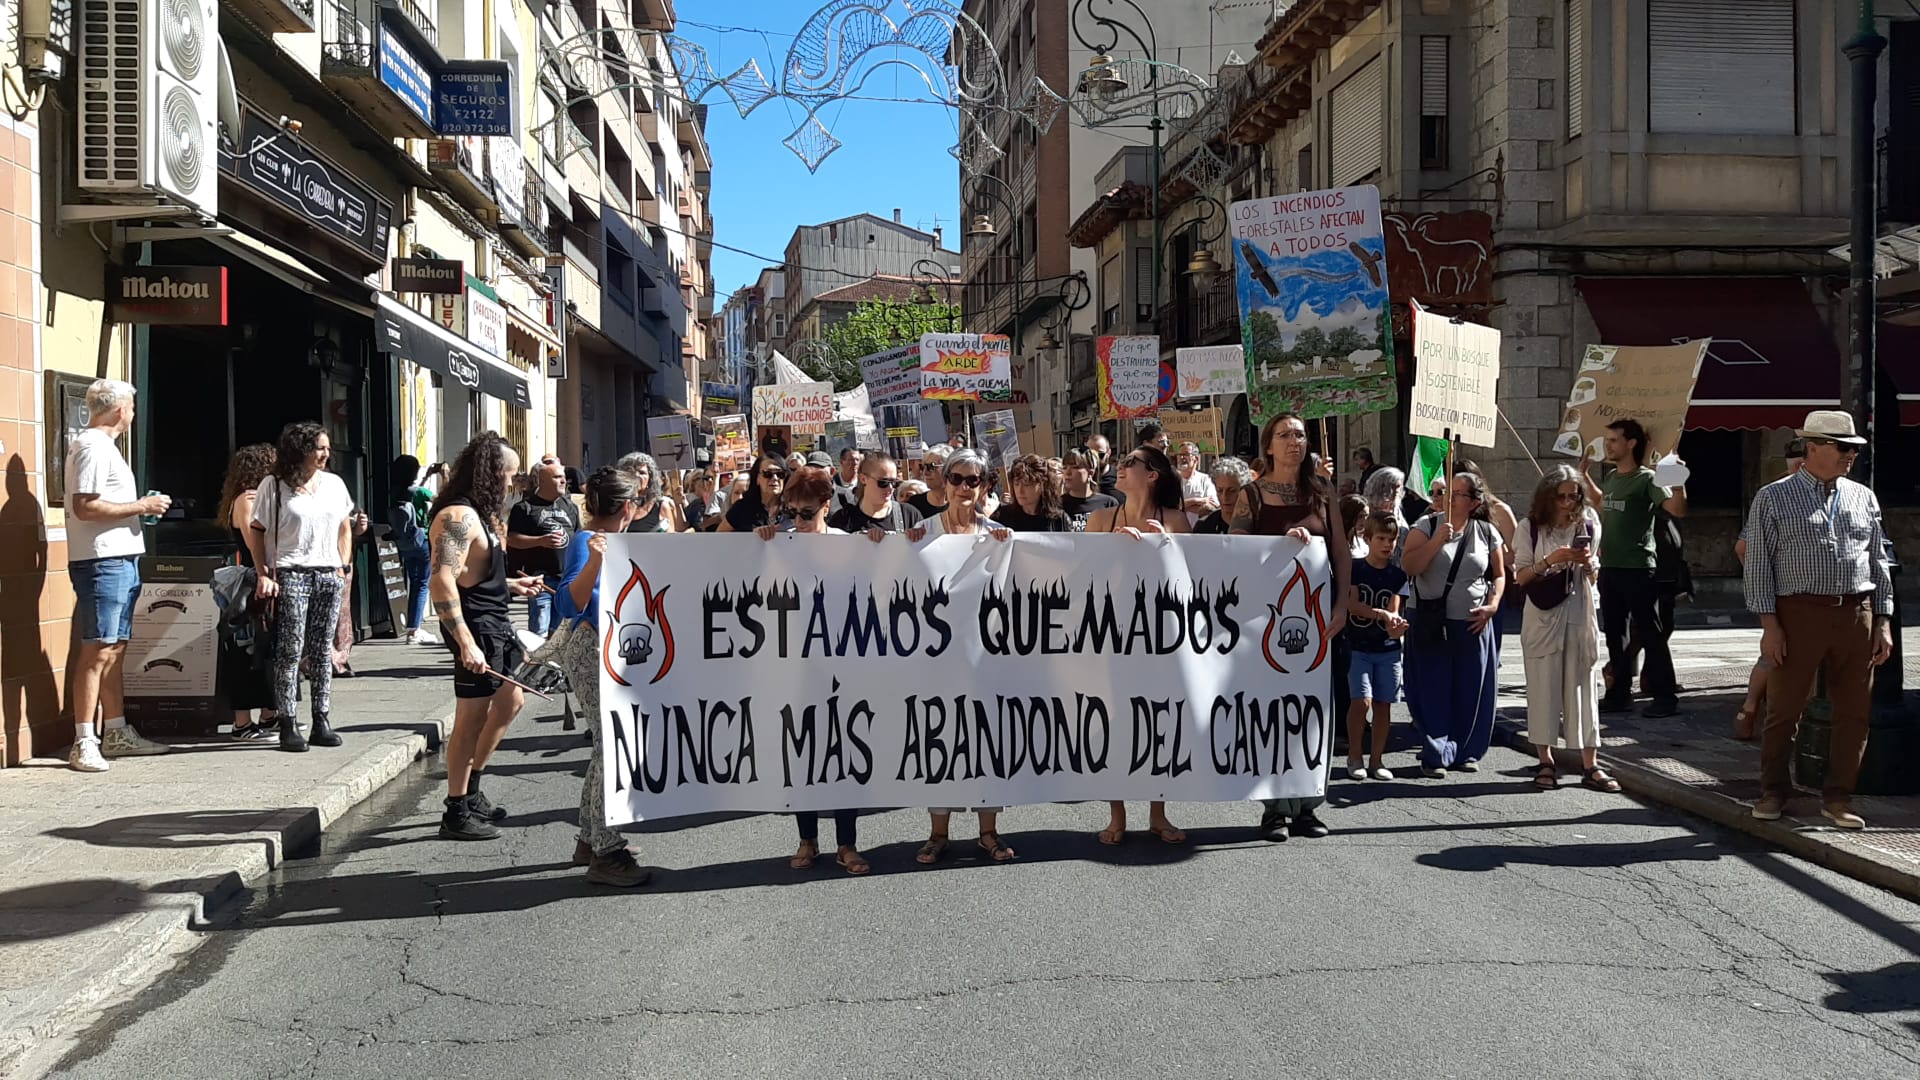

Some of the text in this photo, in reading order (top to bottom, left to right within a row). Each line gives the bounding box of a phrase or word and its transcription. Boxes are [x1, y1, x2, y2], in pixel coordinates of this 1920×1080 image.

[441, 95, 506, 106] SEGUROS
[454, 109, 495, 120] F2122
[292, 166, 301, 193] LA
[1235, 192, 1346, 221] LOS INCENDIOS
[1239, 209, 1365, 239] FORESTALES AFECTAN
[1269, 232, 1348, 257] A TODOS
[400, 264, 455, 279] Mahou
[122, 276, 209, 299] Mahou
[971, 334, 981, 350] el
[1422, 340, 1443, 359] POR
[1448, 345, 1460, 361] UN
[944, 357, 977, 369] ARDE
[924, 374, 936, 387] La
[977, 378, 1009, 390] QUEMA
[1123, 370, 1140, 381] que
[1426, 372, 1481, 395] SOSTENIBLE
[782, 391, 830, 408] NO MÁS
[782, 408, 833, 423] INCENDIOS
[1446, 407, 1461, 424] CON
[1461, 412, 1493, 432] FUTURO
[702, 573, 1241, 660] ESTAMOS QUEMADOS
[609, 674, 1325, 795] NUNCA MÁS ABANDONO DEL CAMPO
